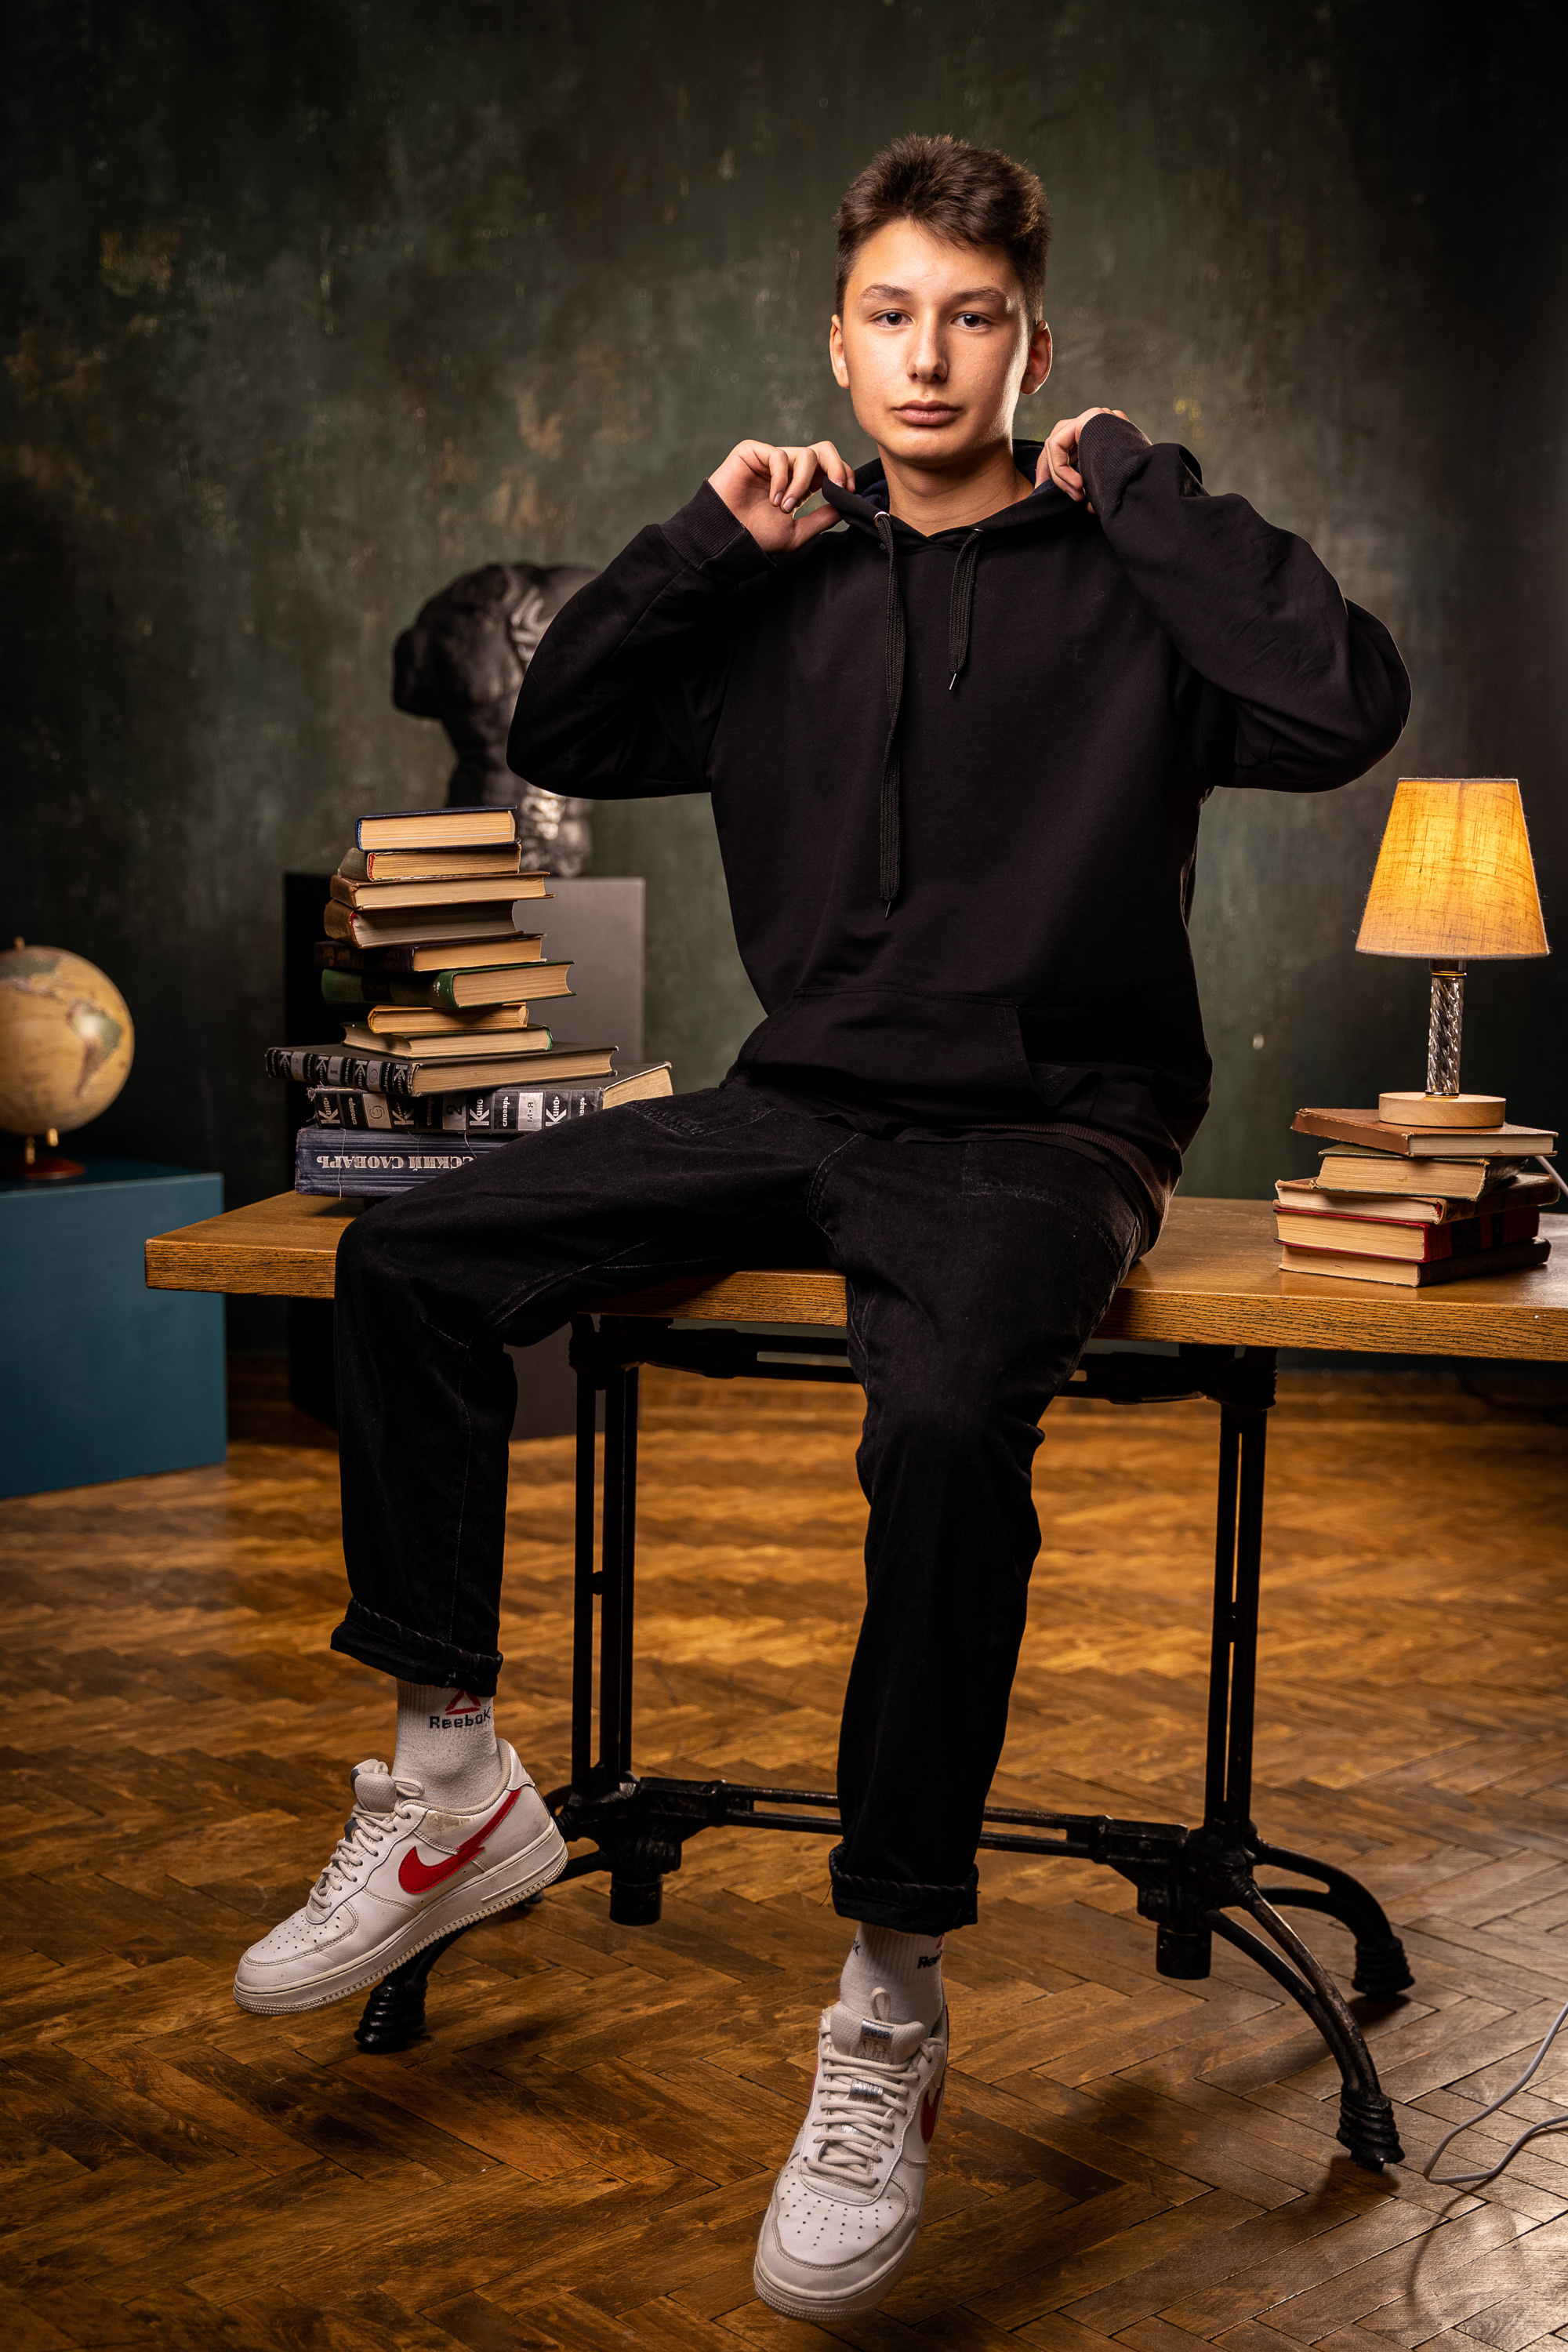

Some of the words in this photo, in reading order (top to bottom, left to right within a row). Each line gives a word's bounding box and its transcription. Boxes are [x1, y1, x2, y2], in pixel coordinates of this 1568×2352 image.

[318, 1099, 341, 1124] Кино
[348, 1097, 358, 1125] словарь
[446, 1104, 463, 1116] 2
[469, 1098, 490, 1127] Кино
[503, 1096, 511, 1127] словарь
[316, 1156, 405, 1170] СЛОВАРЬ
[429, 1706, 492, 1730] Reebok
[864, 2027, 890, 2040] 2020
